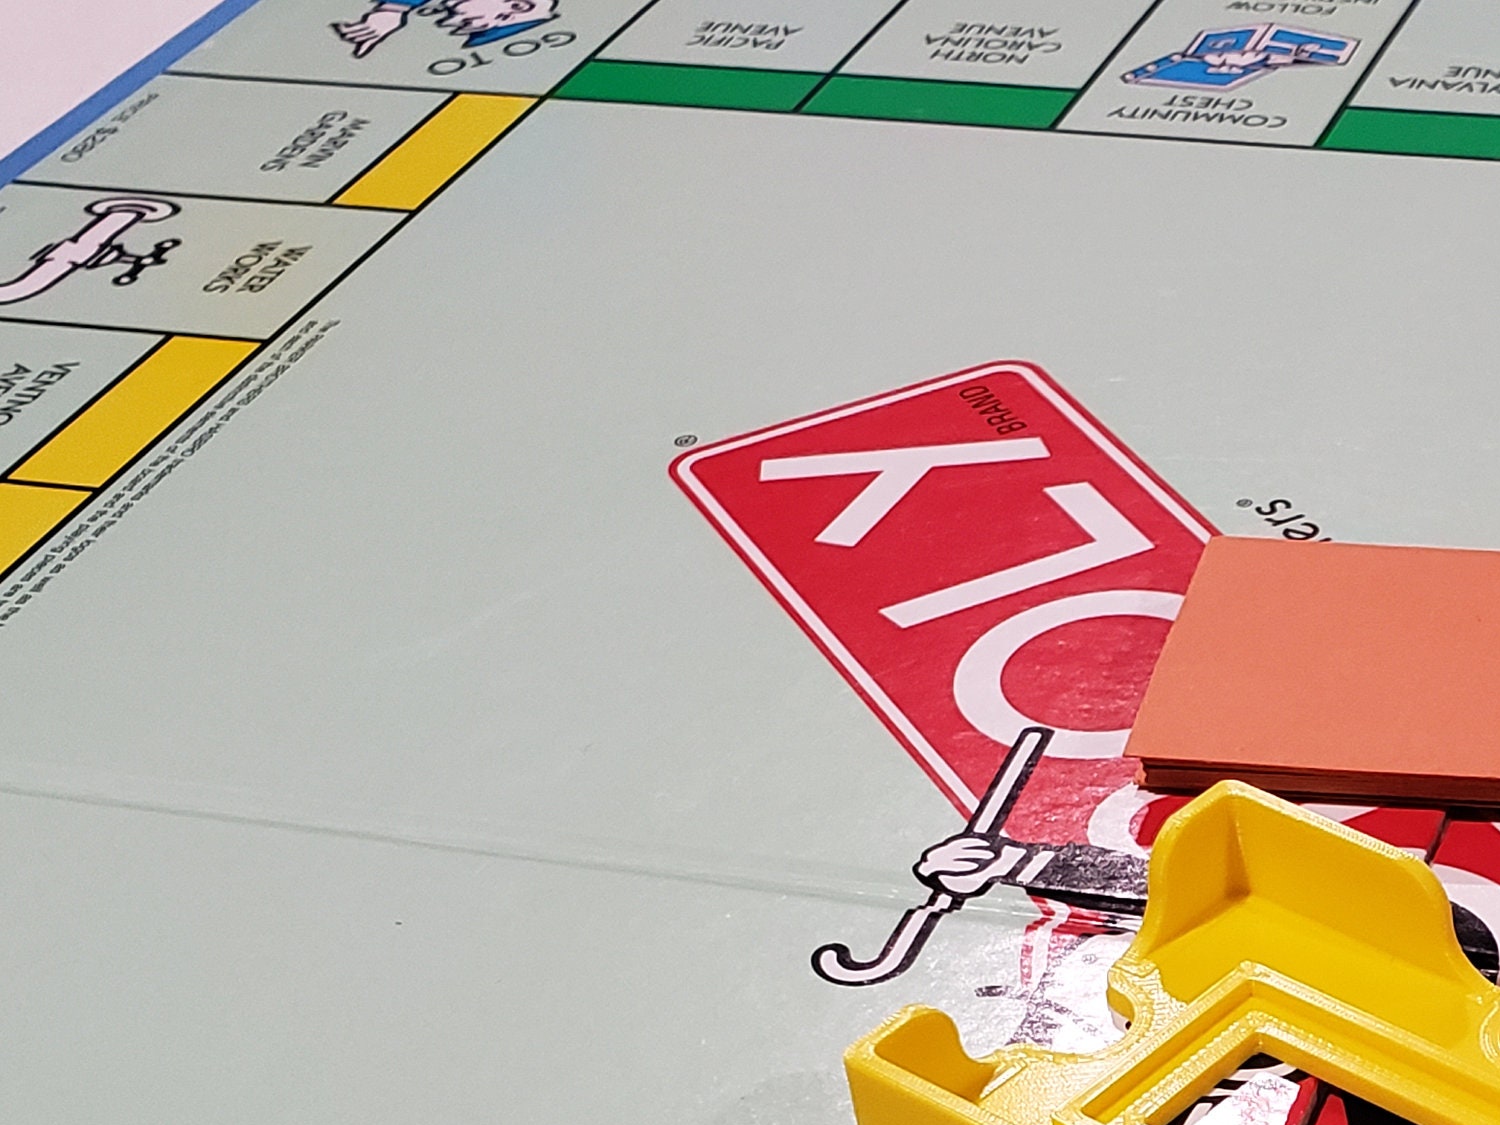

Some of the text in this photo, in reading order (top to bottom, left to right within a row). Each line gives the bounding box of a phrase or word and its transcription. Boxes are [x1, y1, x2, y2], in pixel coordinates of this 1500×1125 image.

[1226, 1, 1339, 16] FOLLOW
[695, 21, 804, 36] AVENUE
[949, 22, 1062, 38] AVENUE
[427, 31, 578, 76] GO TO
[685, 34, 787, 51] PACIFIC
[923, 34, 1063, 54] CAROLINA
[928, 48, 1030, 66] NORTH
[1162, 93, 1256, 112] CHEST
[1107, 105, 1288, 129] COMMUNITY
[260, 110, 348, 172] GARDENS
[299, 117, 371, 169] MARVIN
[202, 240, 284, 294] WORKS
[235, 245, 314, 294] WATER
[959, 385, 1028, 435] BRAND
